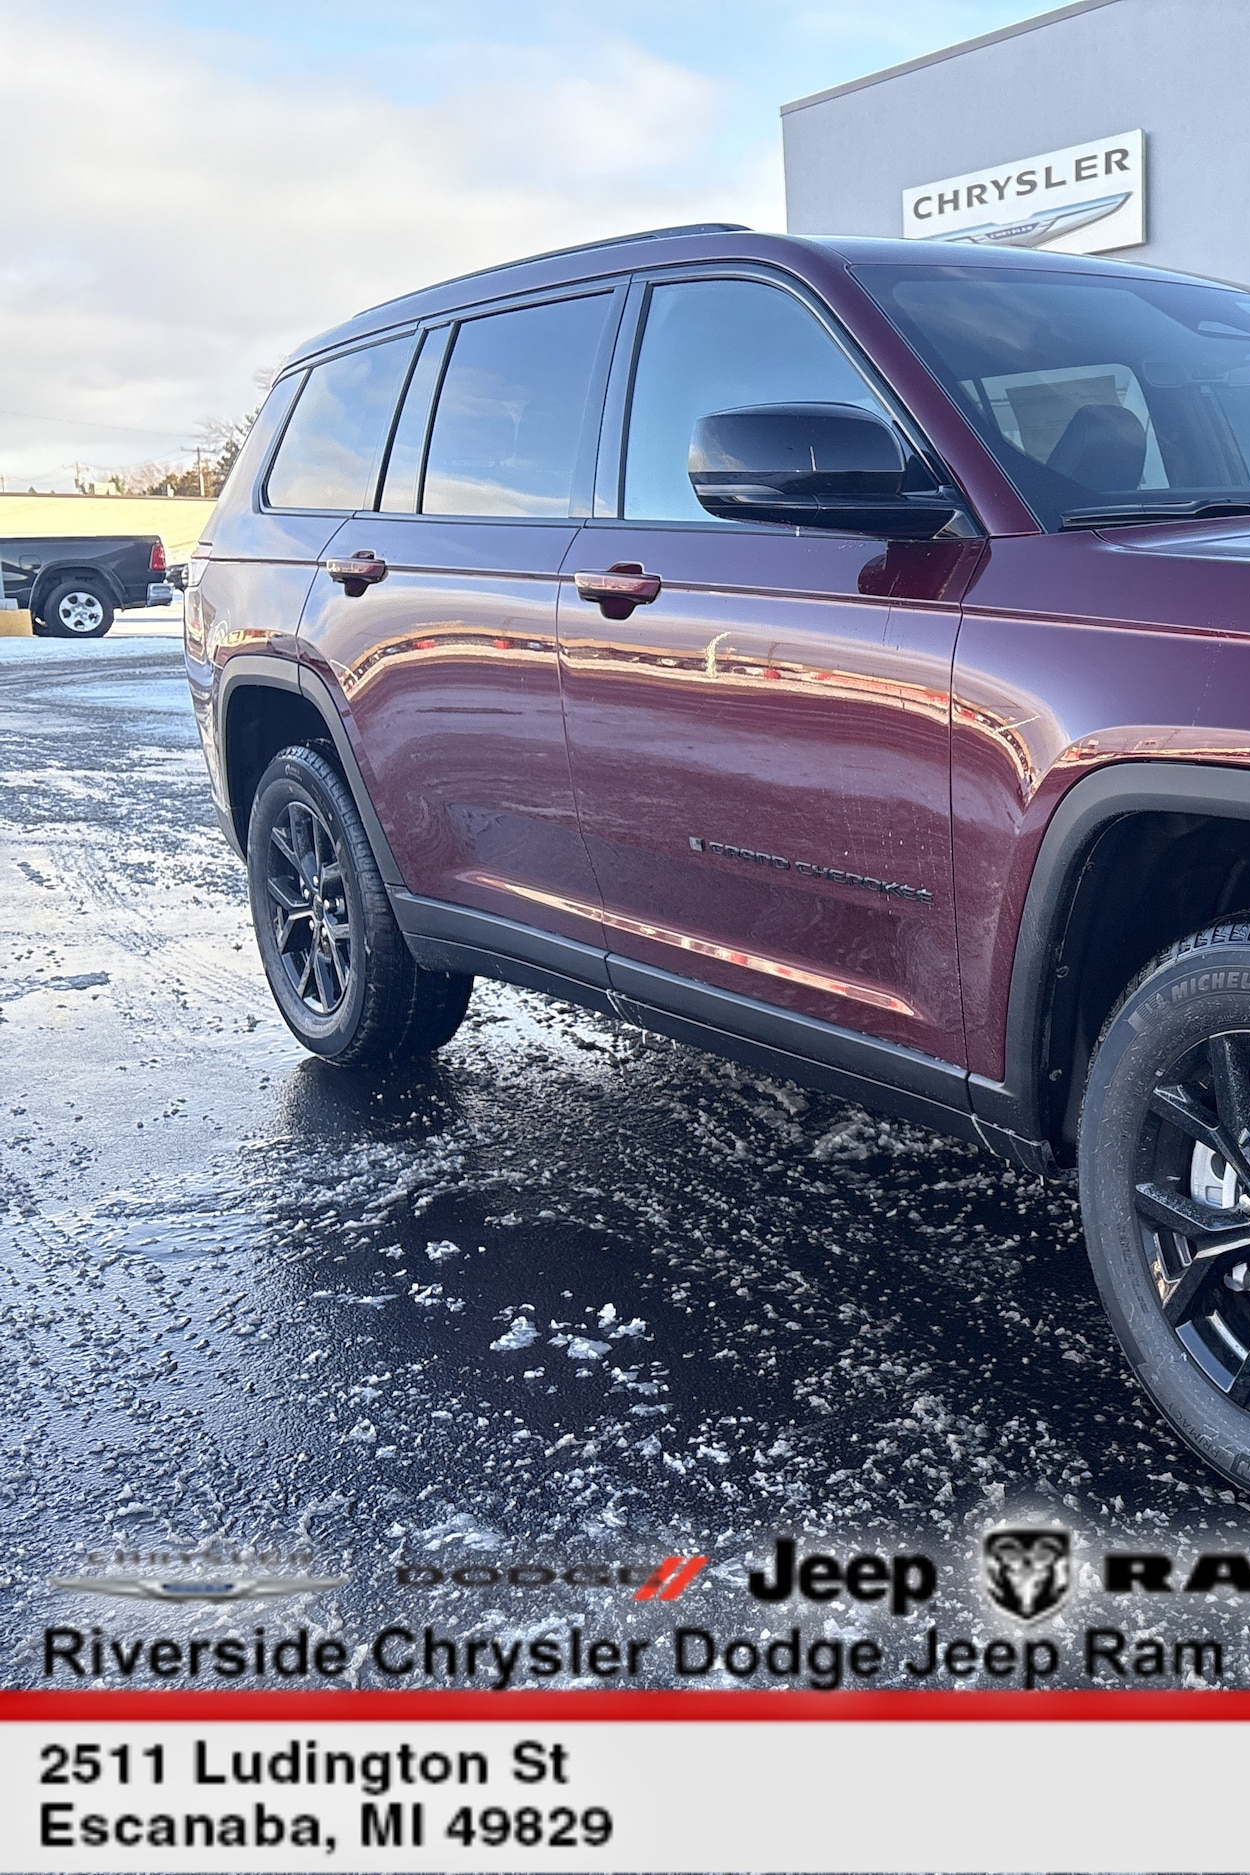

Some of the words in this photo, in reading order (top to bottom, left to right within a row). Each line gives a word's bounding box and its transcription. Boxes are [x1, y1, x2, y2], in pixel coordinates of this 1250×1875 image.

[912, 147, 1131, 220] CHRYSLER
[708, 840, 790, 871] GRAND
[794, 860, 935, 906] CHEROKEE
